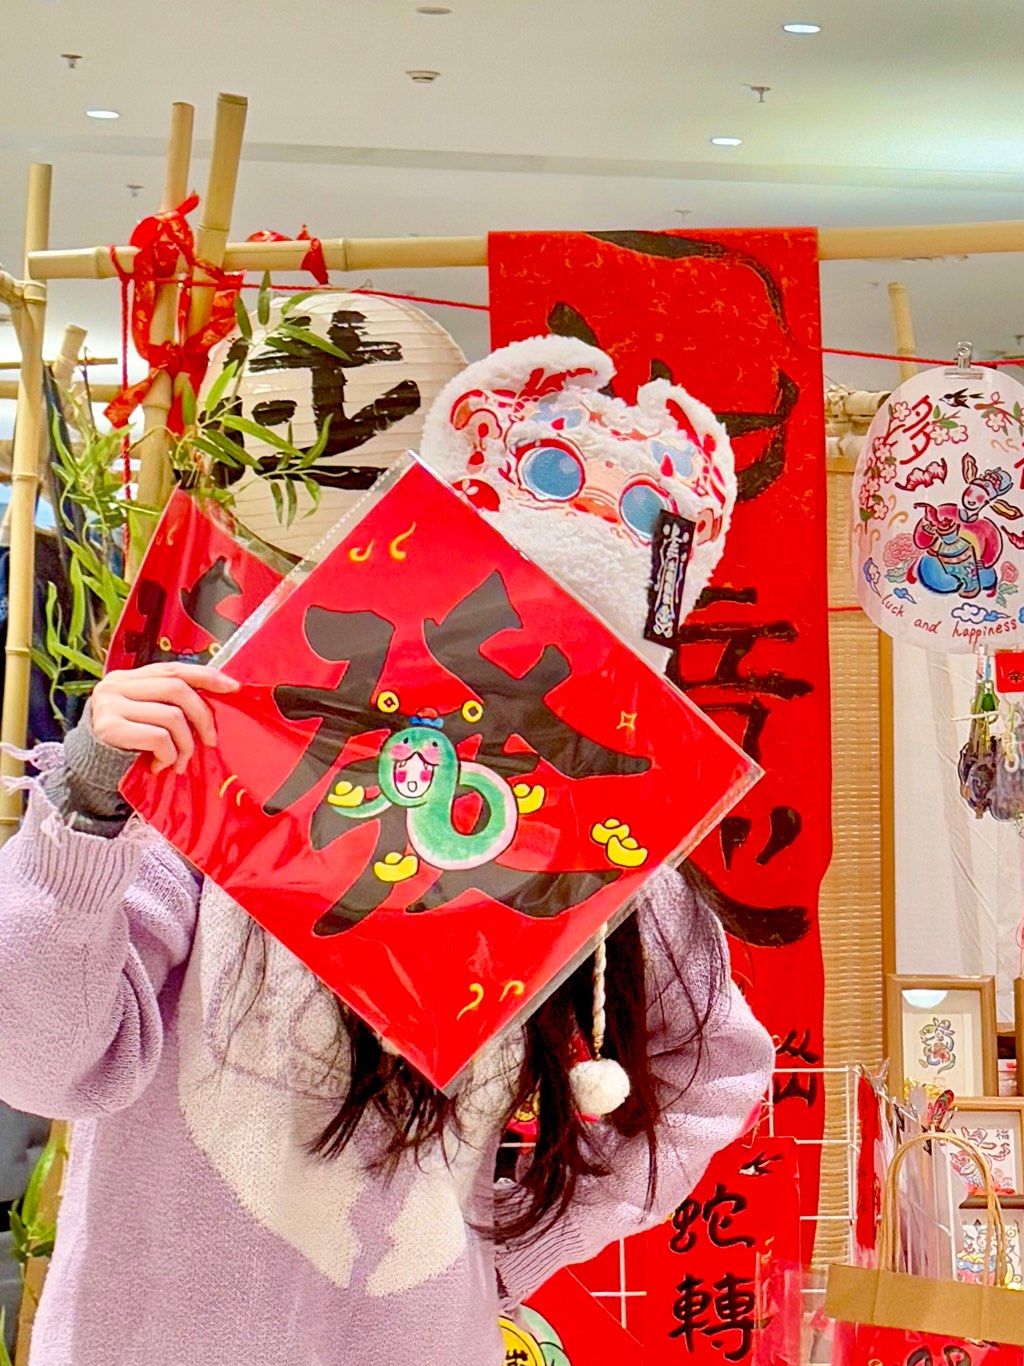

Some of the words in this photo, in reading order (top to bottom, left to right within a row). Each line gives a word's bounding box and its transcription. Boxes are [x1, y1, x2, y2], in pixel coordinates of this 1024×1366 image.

[900, 395, 932, 464] 多
[882, 595, 904, 617] luck
[914, 618, 940, 634] and
[952, 618, 1018, 644] happiness
